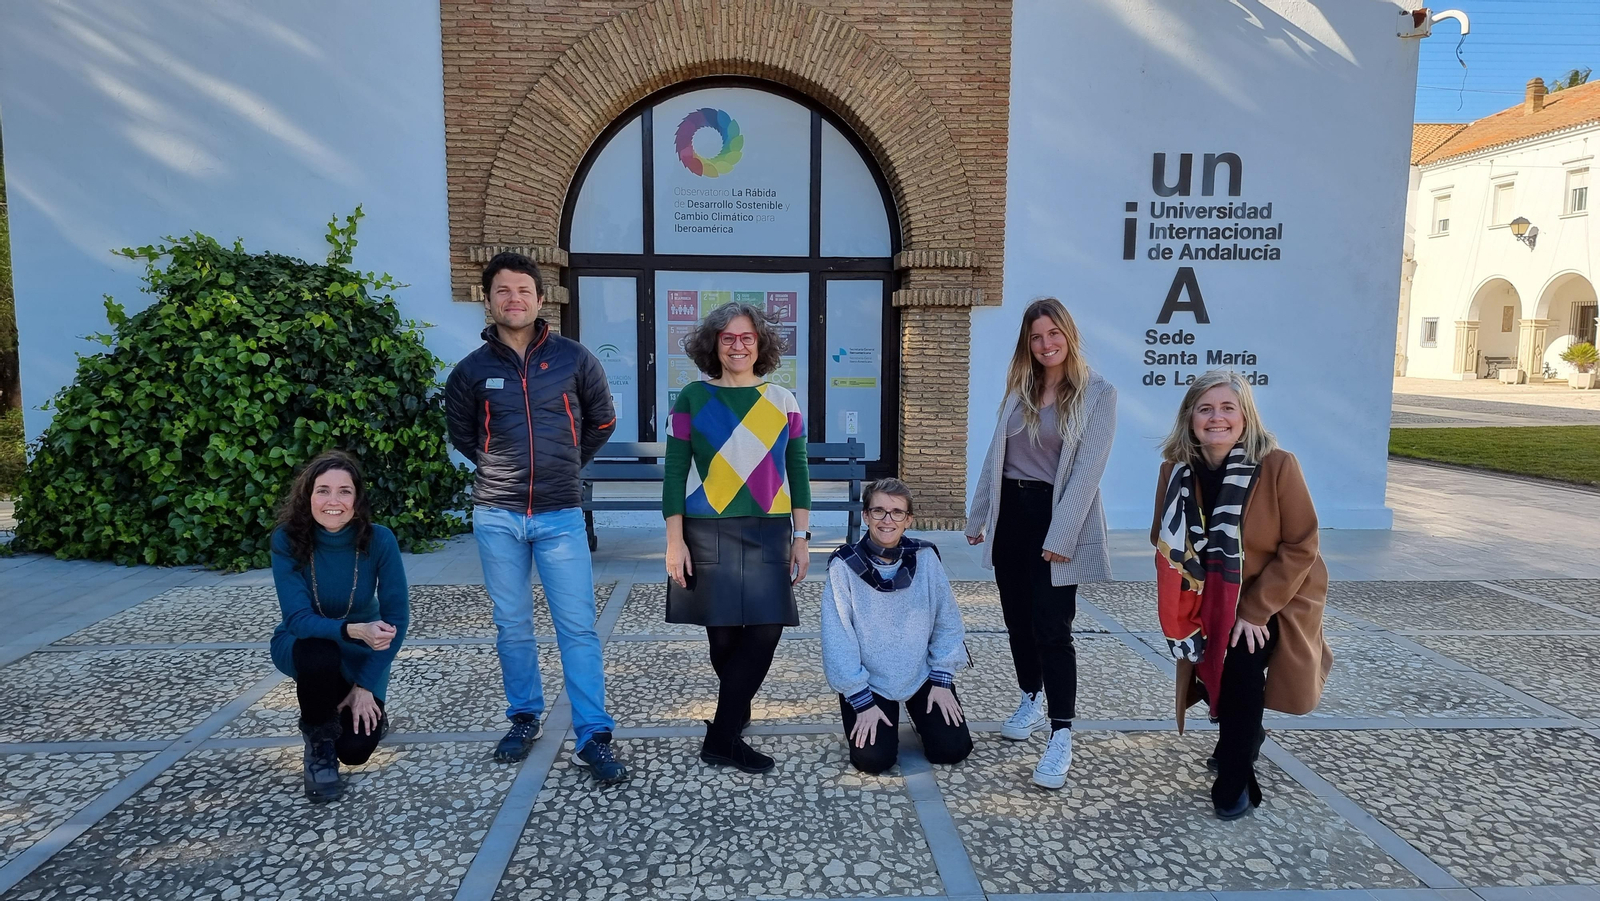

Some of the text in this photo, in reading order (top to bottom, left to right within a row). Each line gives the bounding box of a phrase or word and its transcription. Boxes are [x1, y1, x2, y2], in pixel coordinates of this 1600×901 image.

[1152, 152, 1242, 197] un
[674, 187, 777, 197] Observatorio La Rábida
[674, 199, 791, 212] de Desarrollo Sostenible y
[1150, 201, 1272, 219] Universidad
[674, 212, 775, 223] Cambio Climático para
[674, 224, 734, 234] Iberoamérica
[1149, 222, 1283, 240] Internacional
[1147, 243, 1281, 260] de Andalucía
[1155, 266, 1211, 324] A
[1144, 329, 1195, 345] Sede
[1143, 350, 1257, 365] Santa María
[1142, 371, 1167, 385] de
[1174, 371, 1196, 385] La
